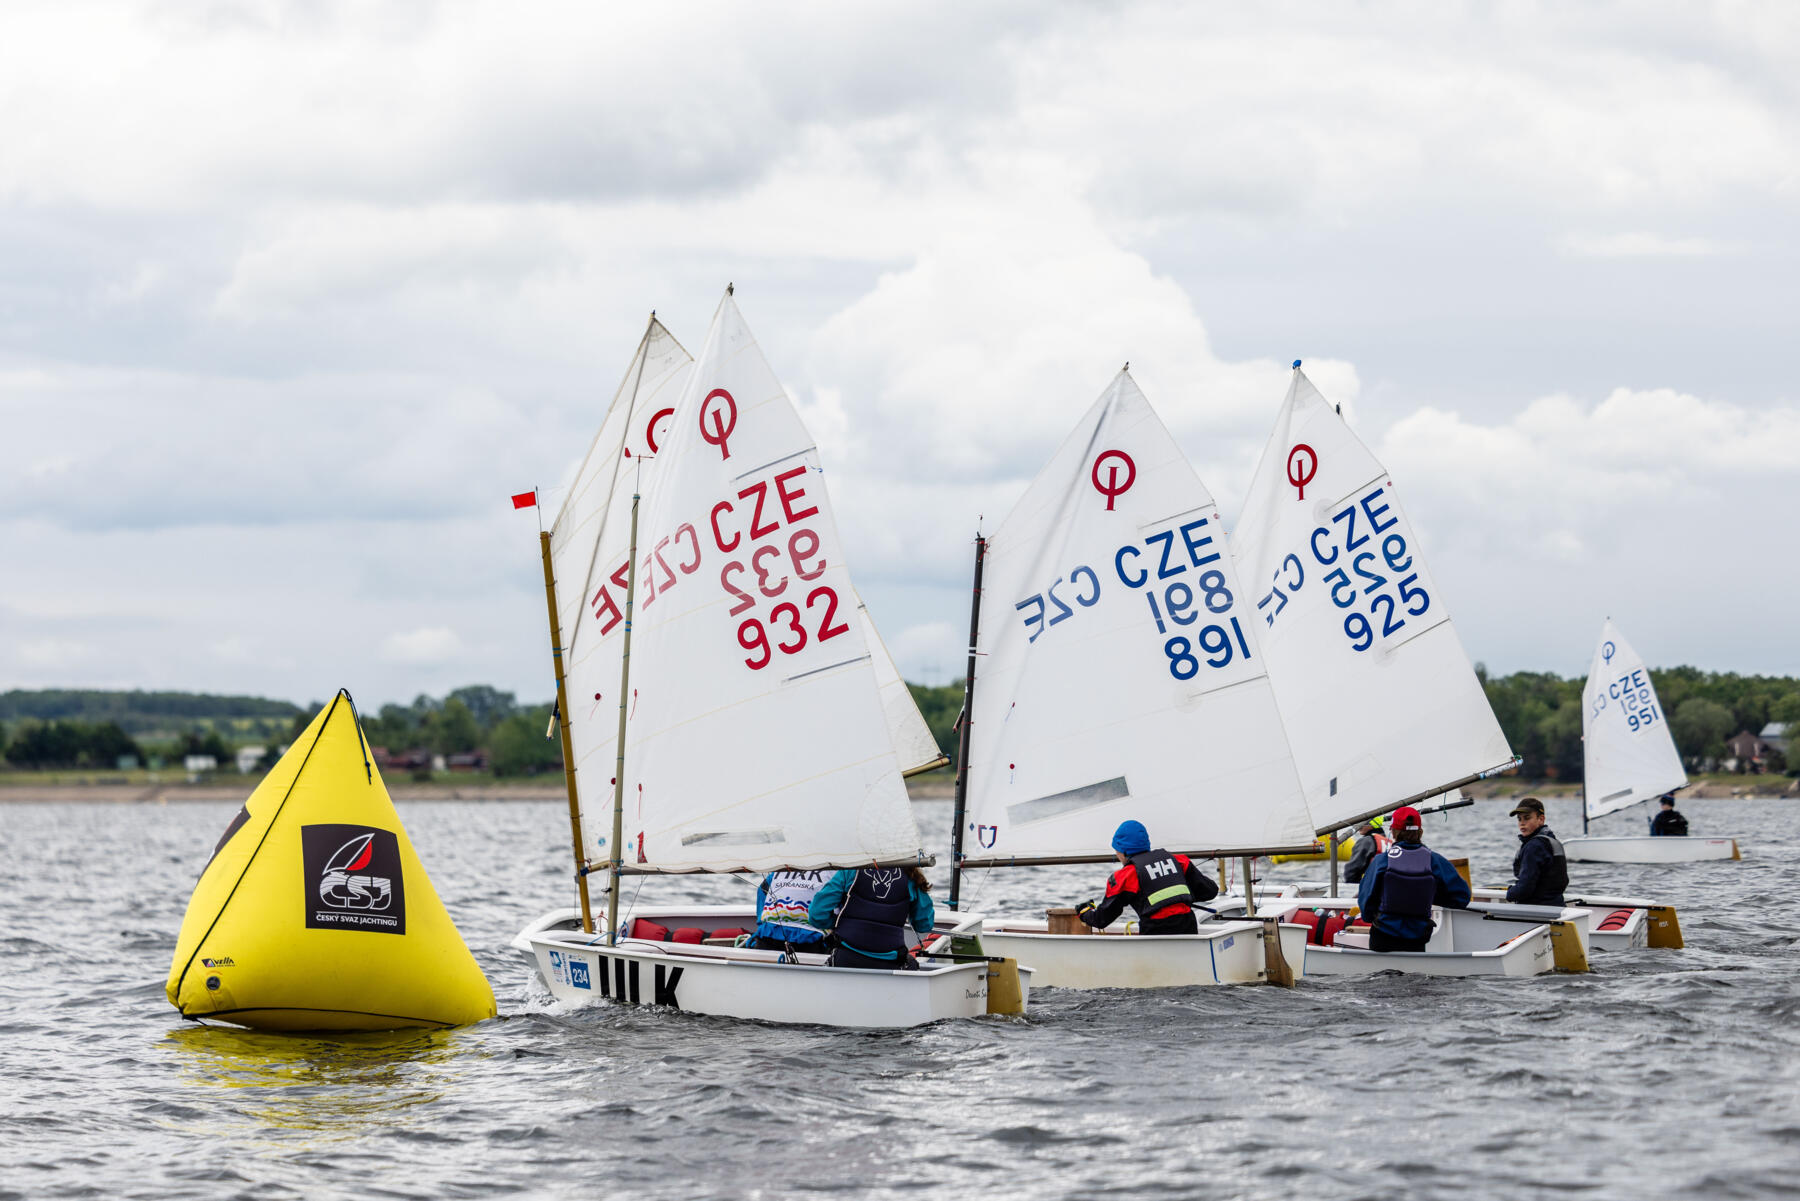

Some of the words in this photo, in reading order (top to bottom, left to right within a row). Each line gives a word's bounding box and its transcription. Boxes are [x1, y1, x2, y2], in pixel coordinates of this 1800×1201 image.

[711, 466, 819, 553] CZE
[1311, 488, 1398, 565] CZE
[1115, 518, 1221, 588] CZE
[737, 586, 849, 670] 932
[1344, 572, 1430, 652] 925
[1164, 616, 1251, 680] 891
[1609, 669, 1646, 700] CZE
[1627, 704, 1658, 732] 951
[1144, 858, 1178, 880] HH
[316, 913, 339, 922] ČESKÝ
[340, 915, 359, 923] SVAZ
[360, 916, 397, 927] JACHTINGU
[573, 968, 589, 985] 234
